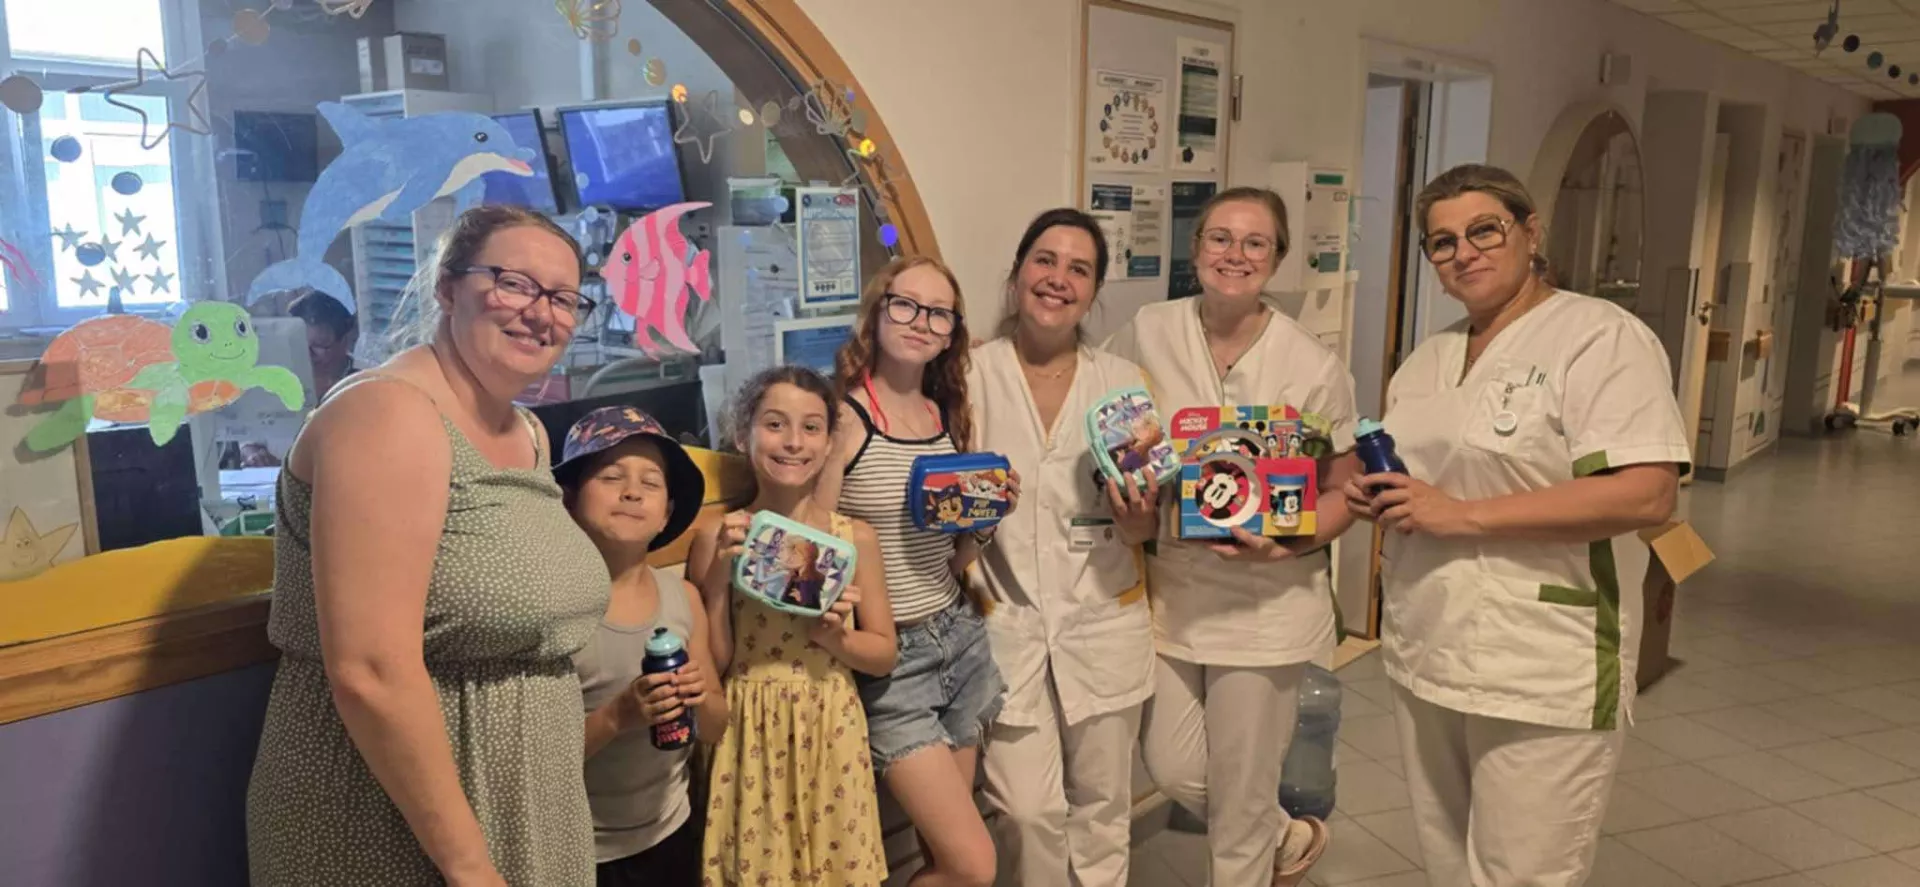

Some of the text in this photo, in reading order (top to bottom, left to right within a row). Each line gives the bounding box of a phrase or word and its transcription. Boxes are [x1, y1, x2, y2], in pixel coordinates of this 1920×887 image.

[1179, 416, 1208, 424] MICKEY
[1180, 424, 1207, 432] MOUSE
[968, 508, 998, 518] POWER
